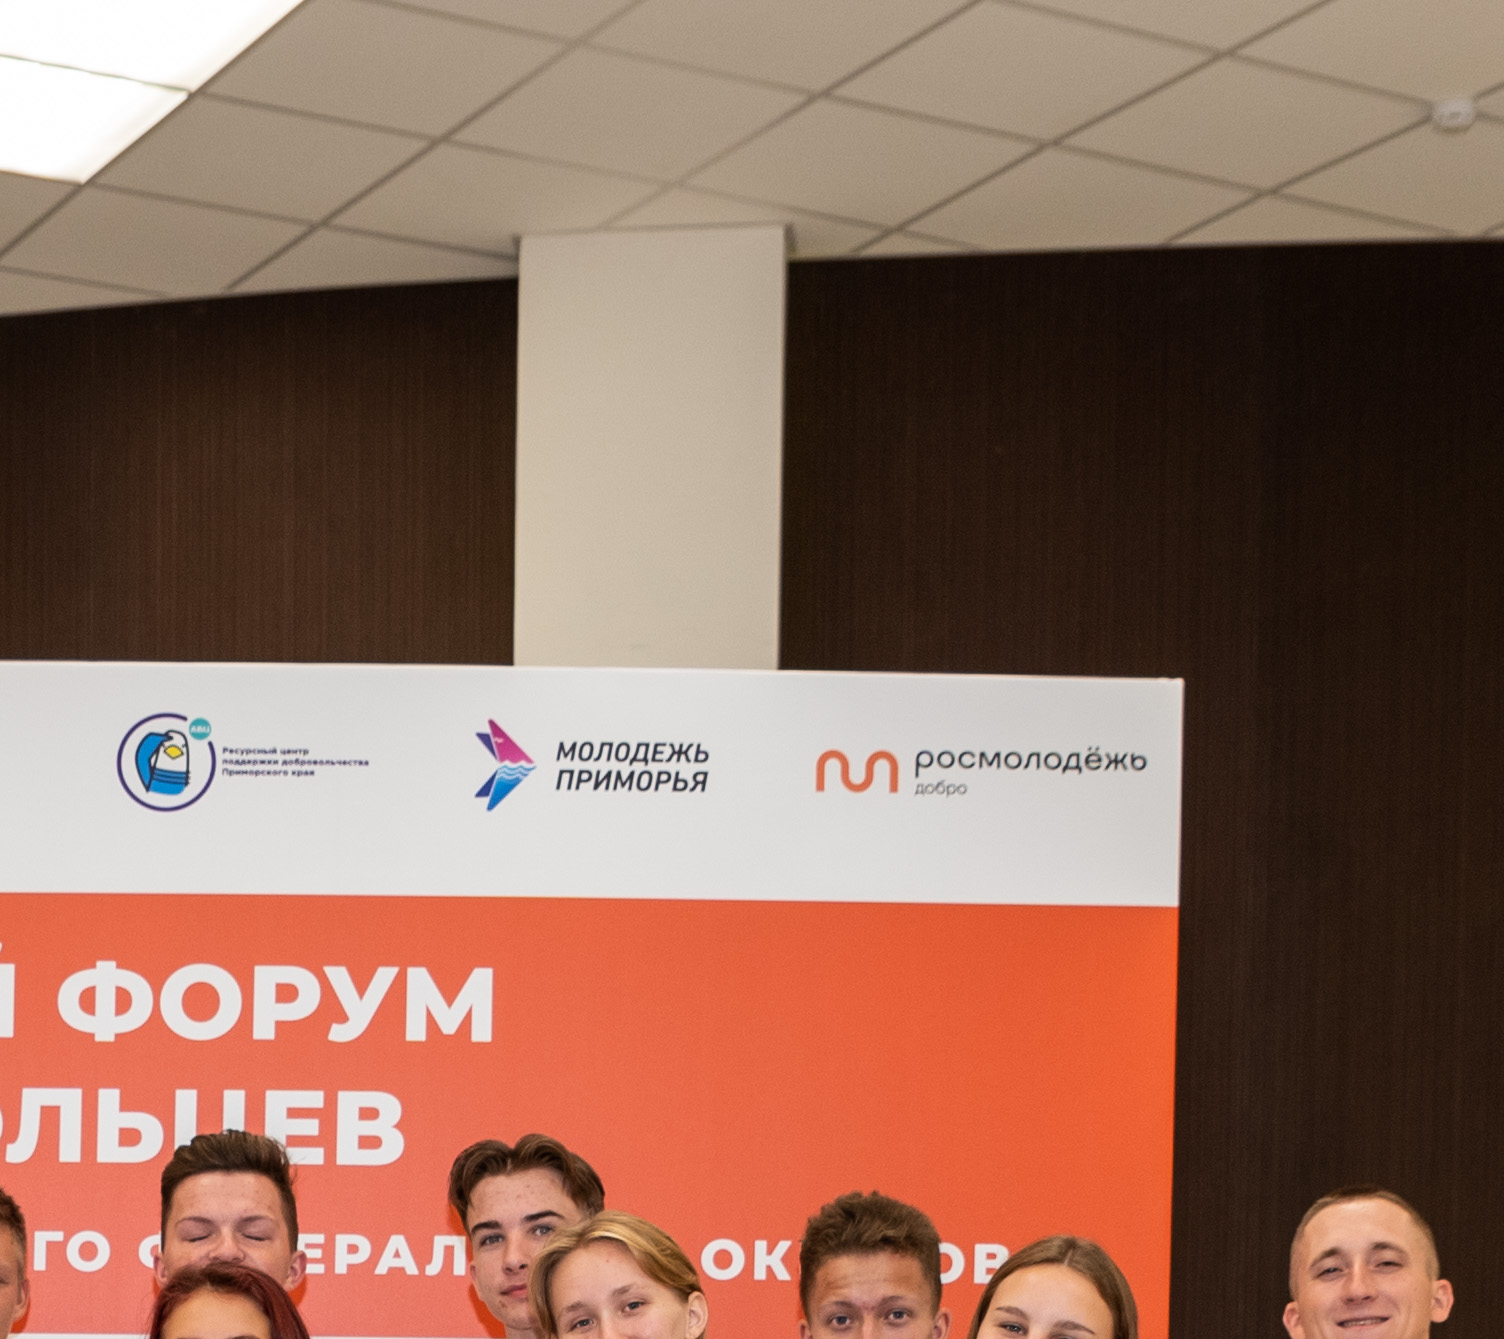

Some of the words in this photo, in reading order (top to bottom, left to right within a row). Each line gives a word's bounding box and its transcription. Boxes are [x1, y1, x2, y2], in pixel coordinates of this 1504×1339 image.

[555, 740, 710, 766] МОЛОДЕЖЬ
[914, 744, 1148, 777] росмолодёжь
[555, 768, 709, 793] ПРИМОРЬЯ
[914, 780, 968, 797] добро
[57, 960, 494, 1043] ФОРУМ
